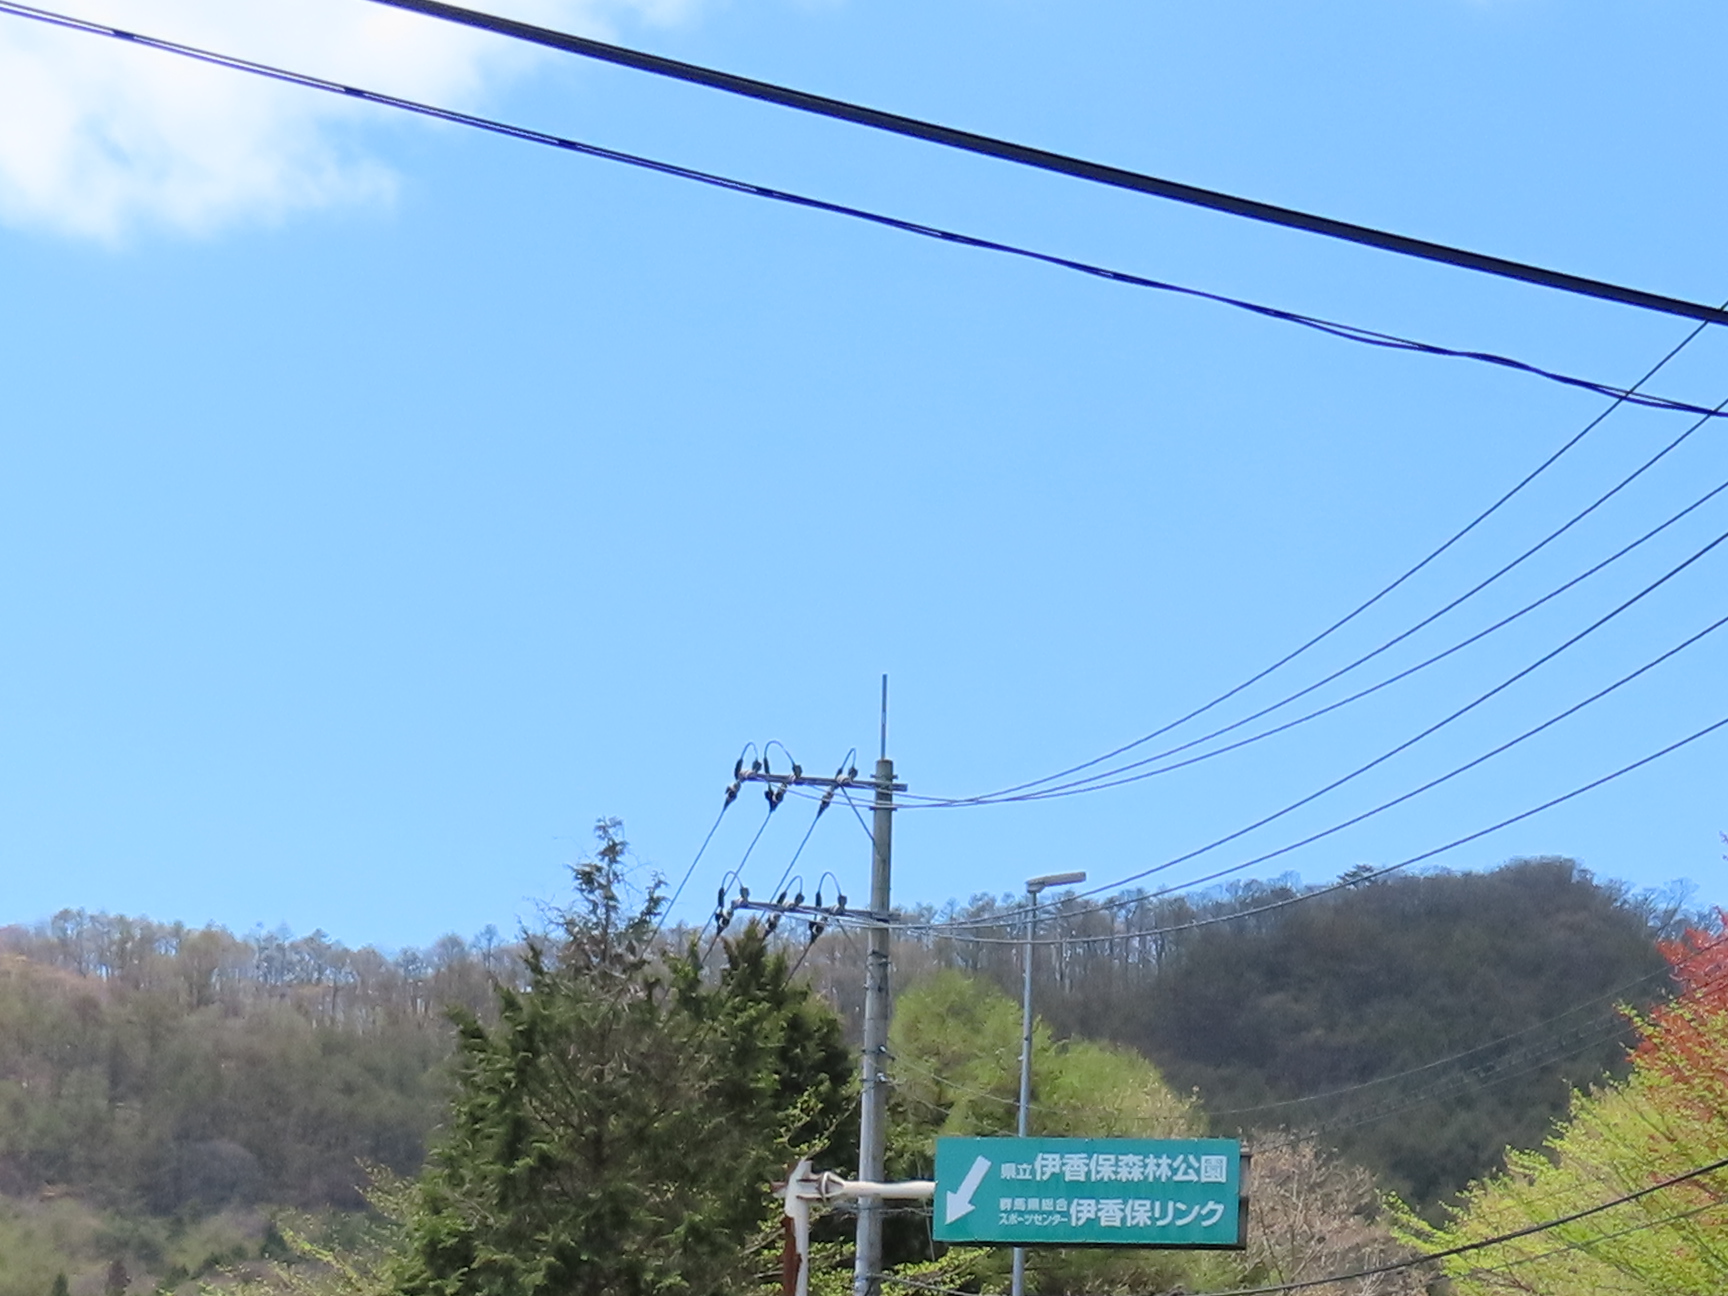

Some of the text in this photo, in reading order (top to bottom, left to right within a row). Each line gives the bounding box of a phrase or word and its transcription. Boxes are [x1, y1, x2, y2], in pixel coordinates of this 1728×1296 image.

[998, 1212, 1069, 1226] スポーツセンター
[1069, 1198, 1225, 1227] 伊香保リンク
